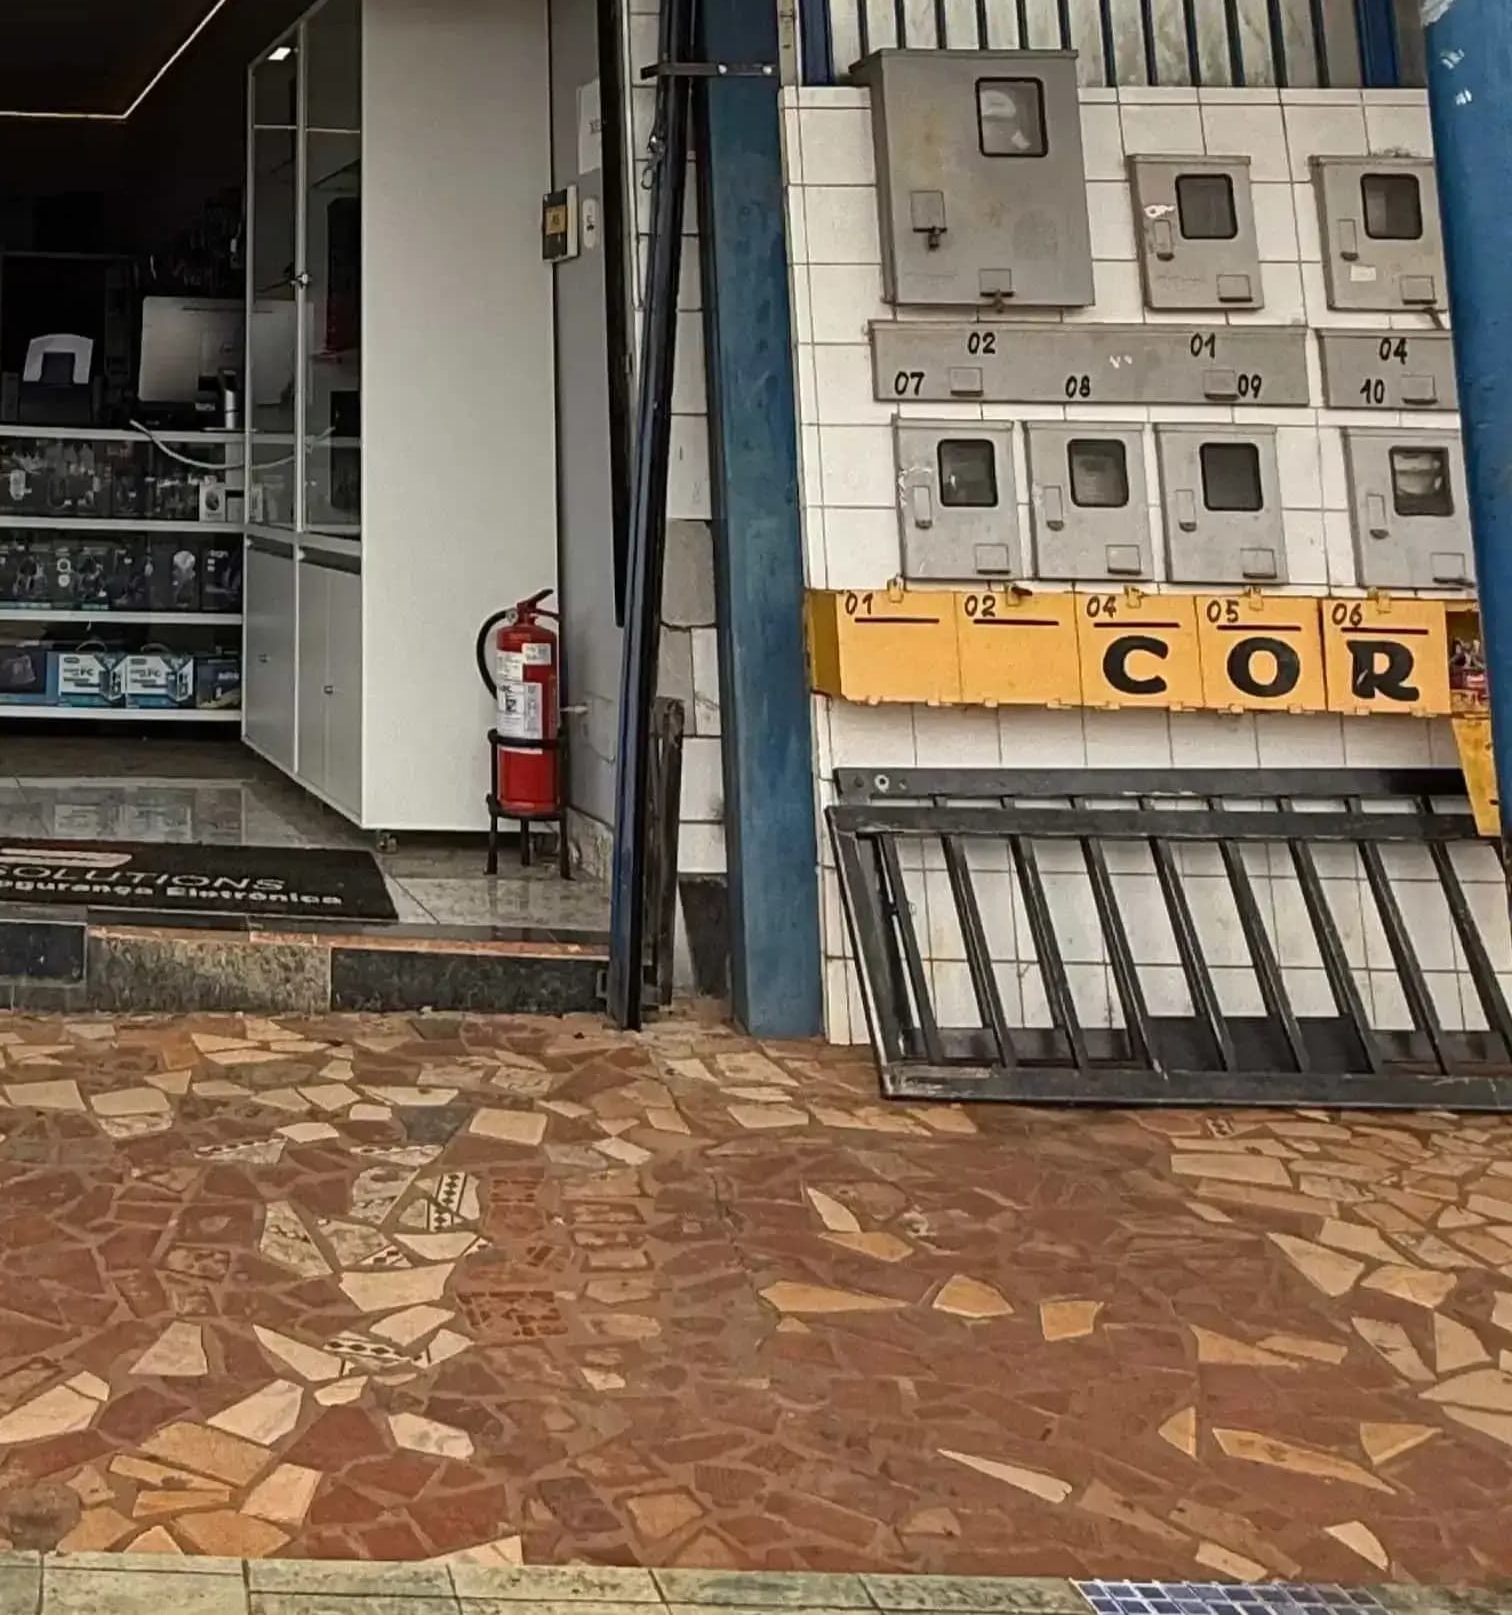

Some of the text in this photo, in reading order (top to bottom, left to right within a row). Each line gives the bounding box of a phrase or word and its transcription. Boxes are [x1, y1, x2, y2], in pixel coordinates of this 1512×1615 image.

[968, 332, 1408, 364] 02 01 04
[894, 371, 1385, 404] 07 08 09 10
[844, 592, 1363, 626] 01 02 04 05 06
